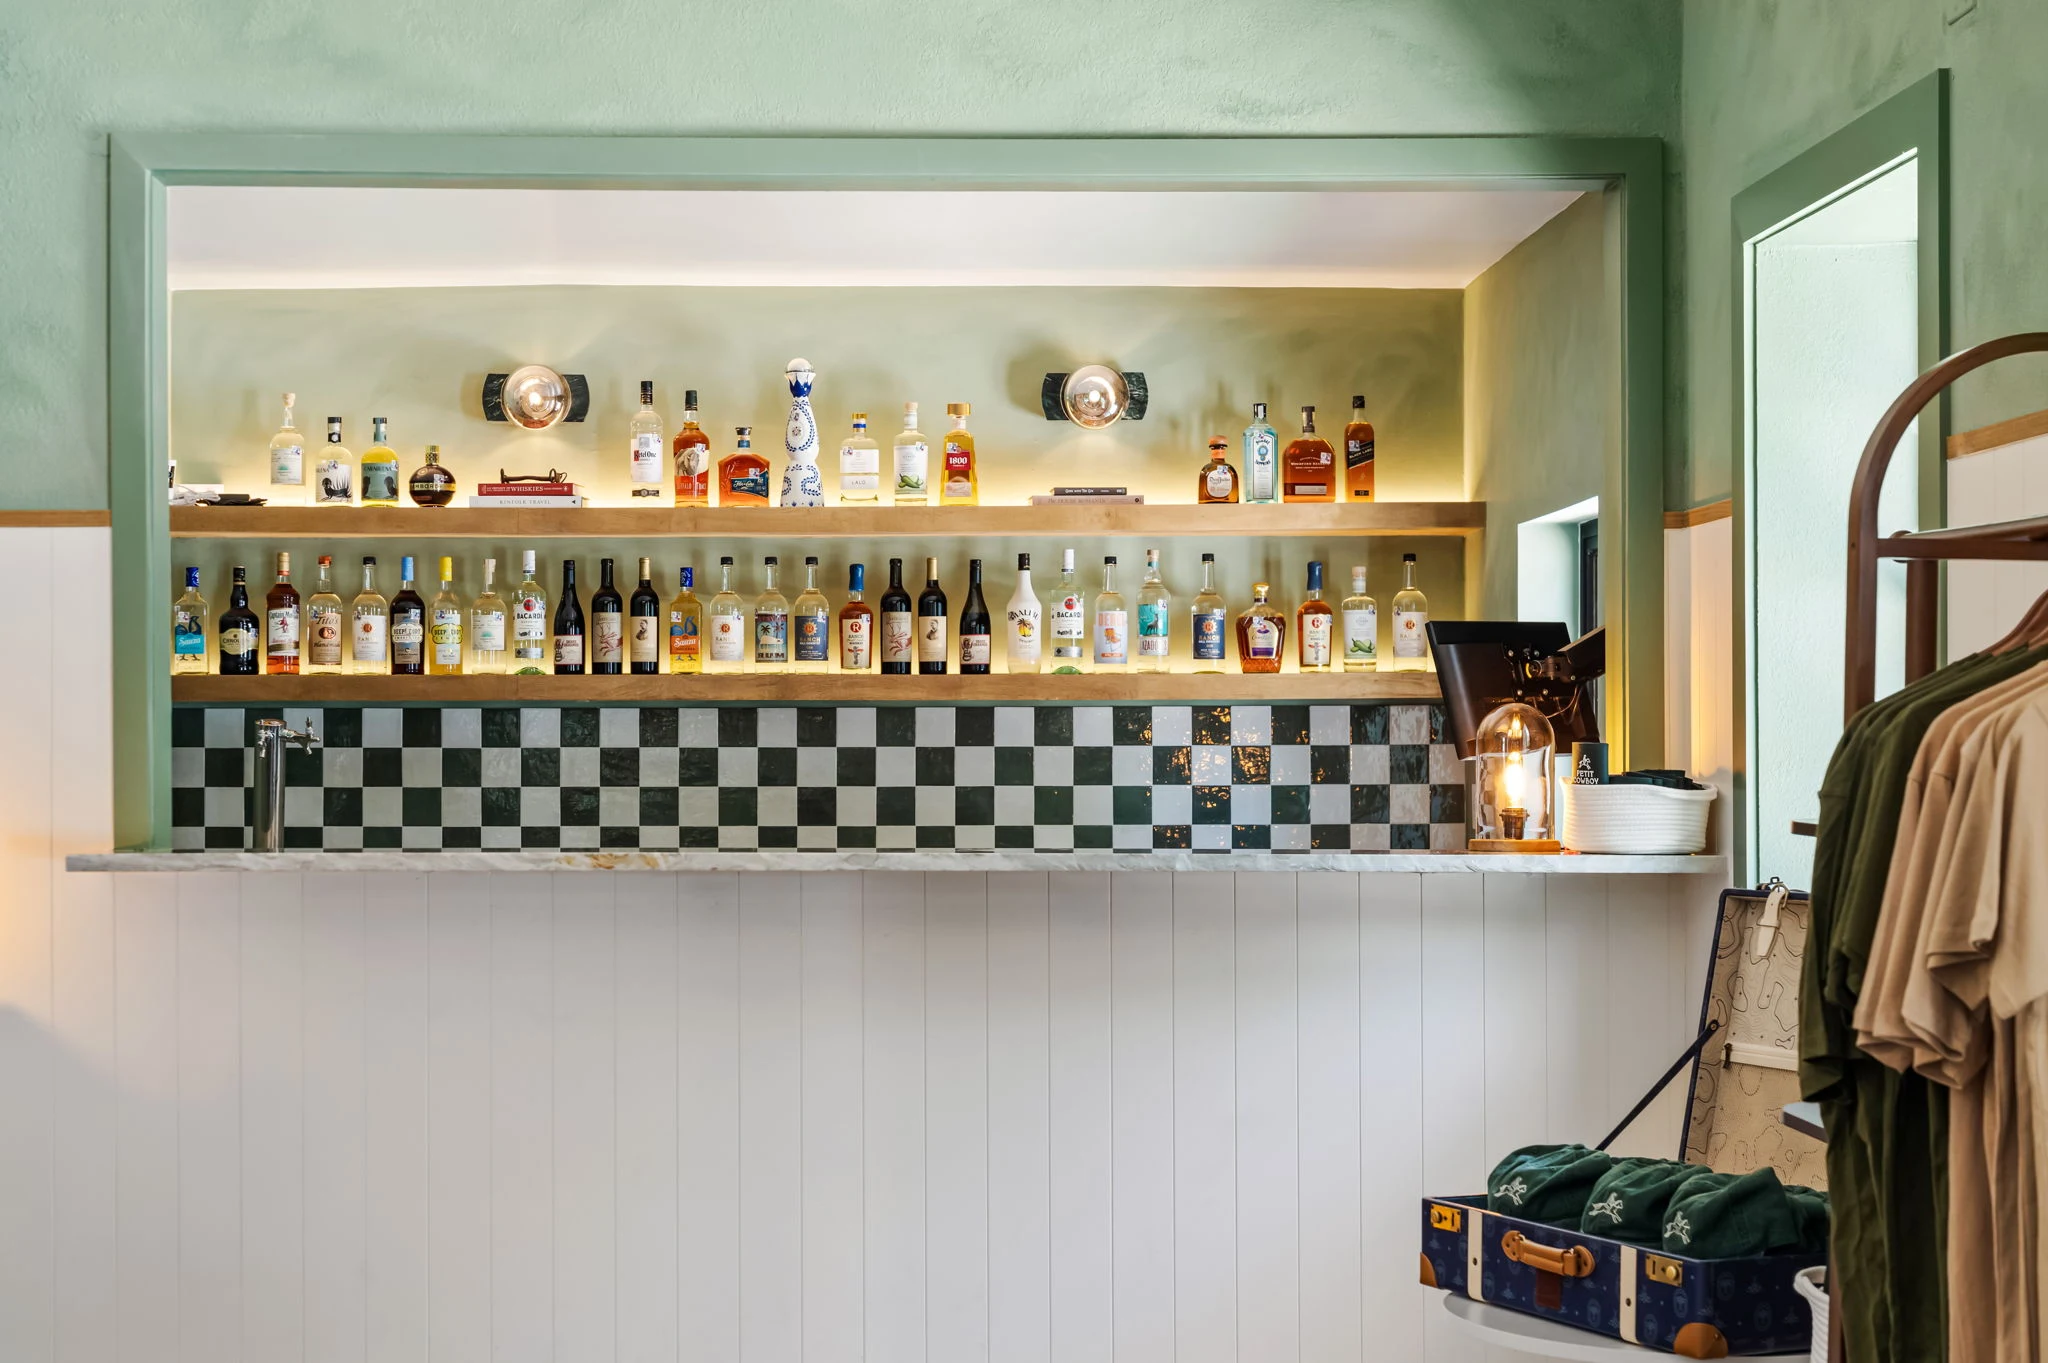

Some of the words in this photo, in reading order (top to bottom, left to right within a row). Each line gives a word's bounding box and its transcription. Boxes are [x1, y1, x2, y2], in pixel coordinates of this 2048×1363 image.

[634, 450, 647, 460] Ketel
[647, 450, 657, 458] One
[317, 616, 338, 625] Tito's
